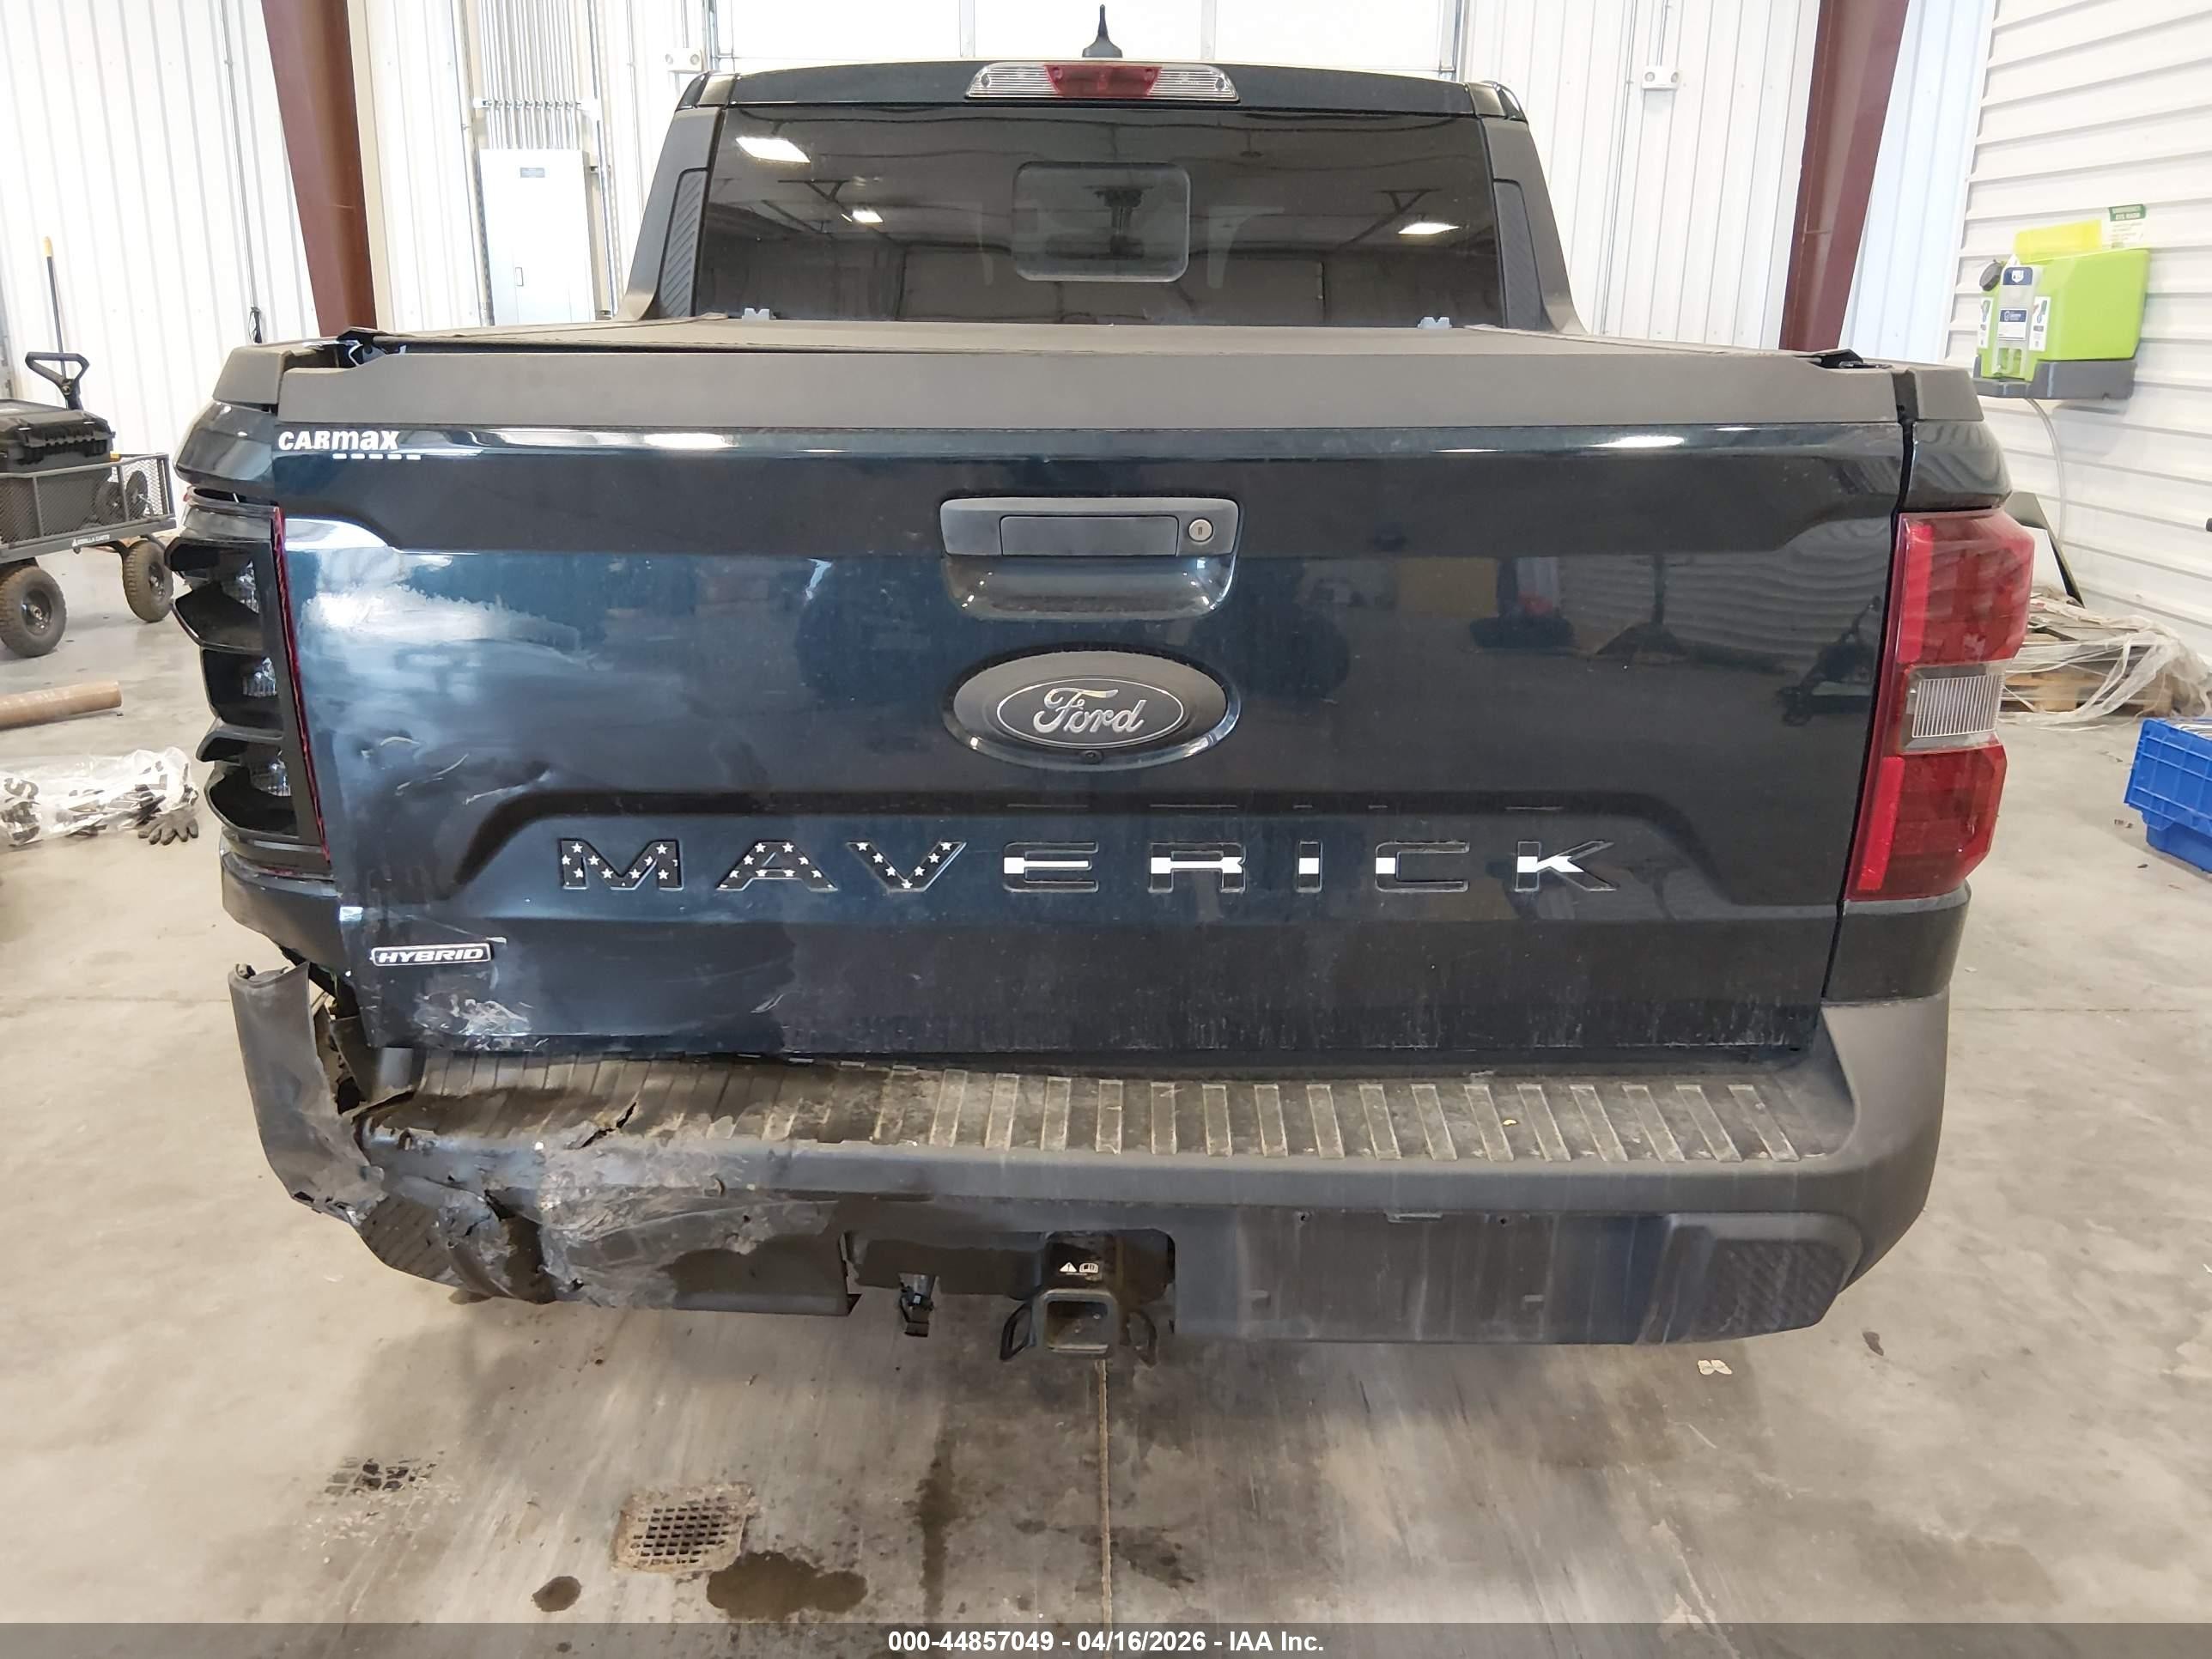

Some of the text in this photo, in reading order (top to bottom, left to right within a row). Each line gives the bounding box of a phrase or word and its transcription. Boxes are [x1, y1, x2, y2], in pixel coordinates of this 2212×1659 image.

[1033, 687, 1147, 733] Ford
[560, 839, 1617, 893] MAVERICK
[378, 949, 484, 963] HYBRID
